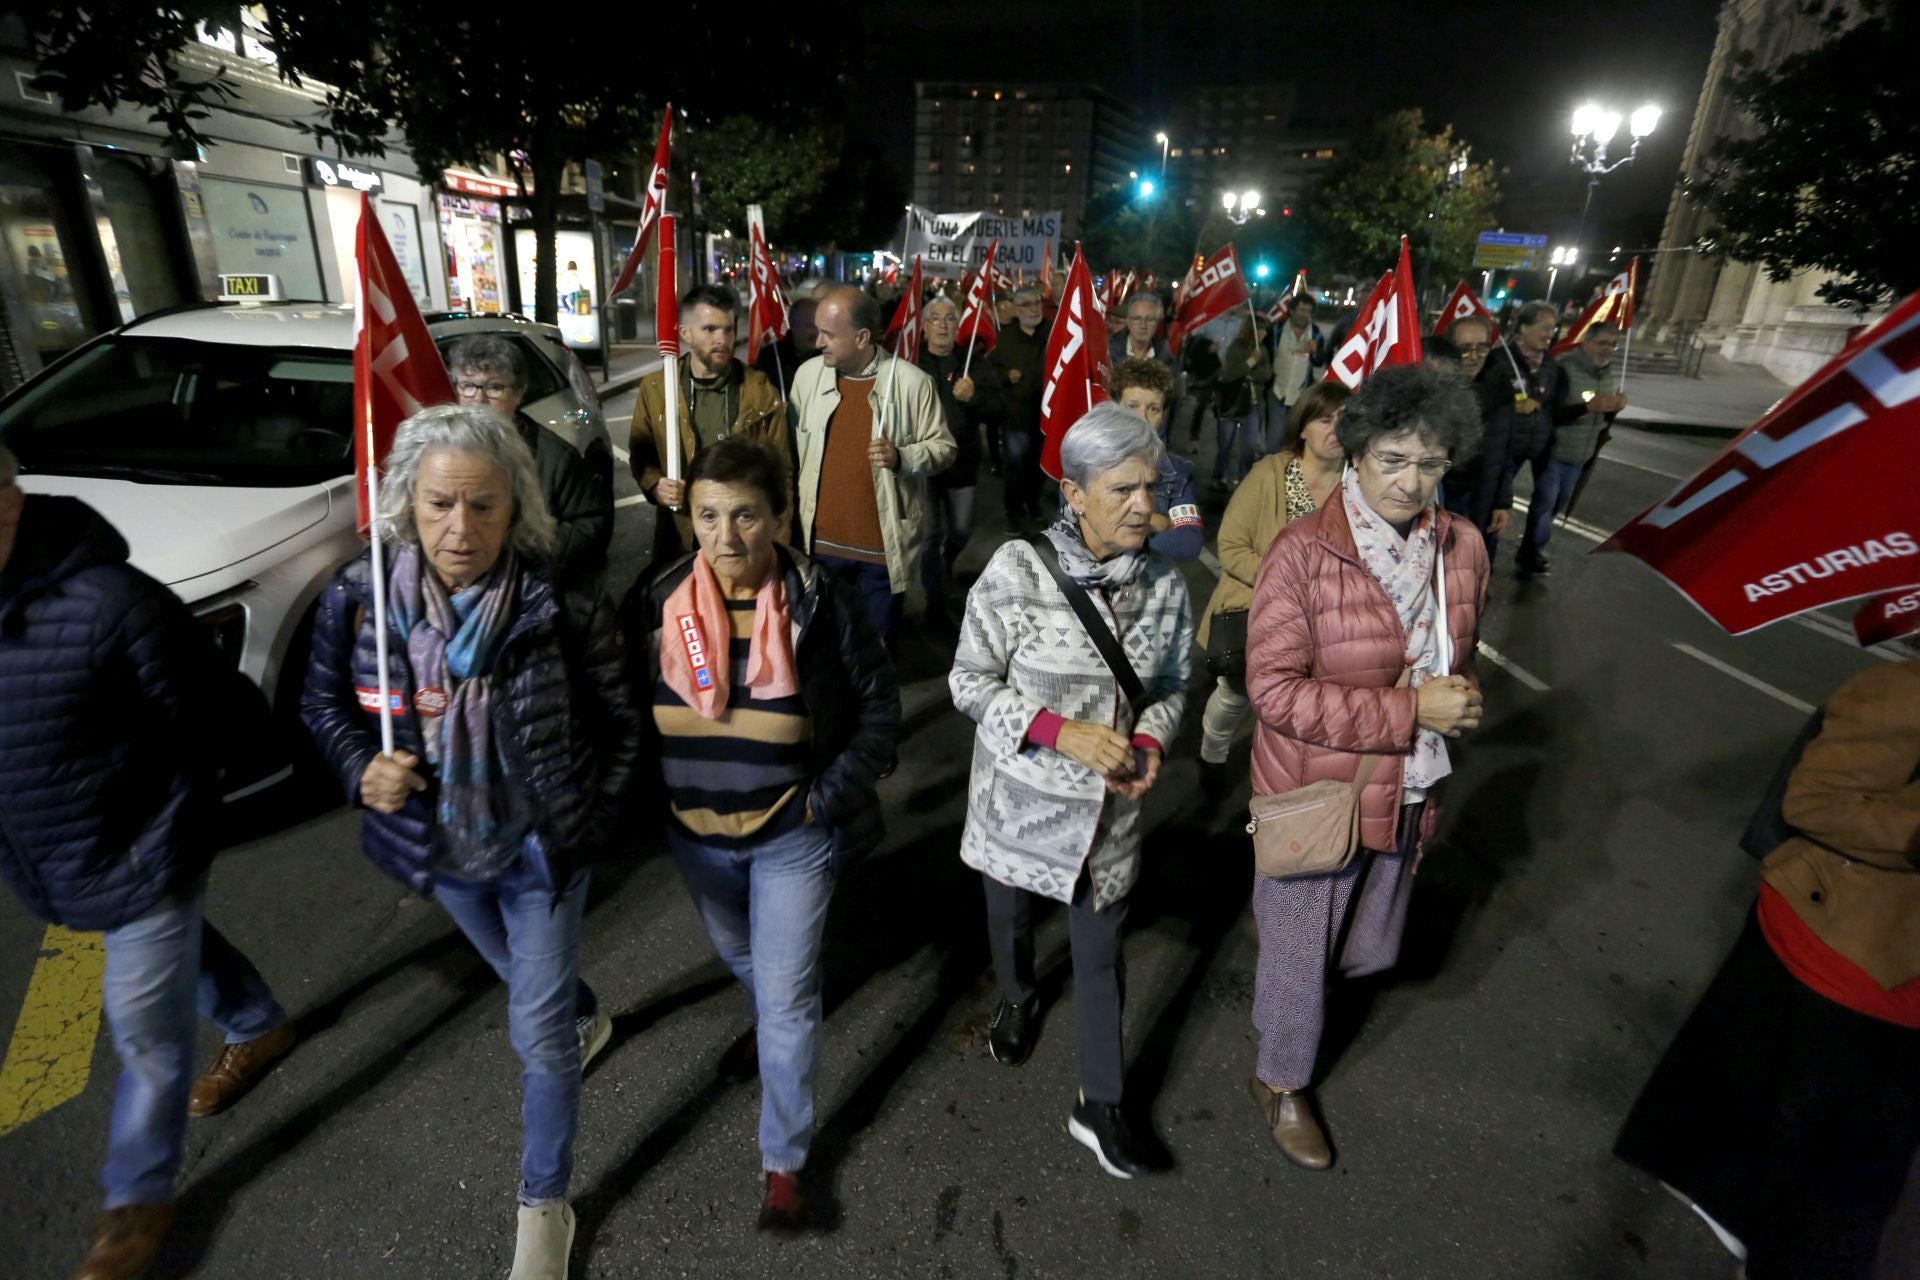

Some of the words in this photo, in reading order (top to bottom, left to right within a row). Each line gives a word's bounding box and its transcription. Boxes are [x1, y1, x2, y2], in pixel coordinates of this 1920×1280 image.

[912, 214, 926, 232] NI
[930, 218, 959, 239] UNA
[965, 218, 1018, 238] MUERTE
[928, 243, 947, 261] EN
[951, 245, 966, 263] EL
[973, 244, 1034, 264] TRBAJO
[227, 277, 258, 295] TAXI
[1743, 531, 1920, 603] ASTURIAS
[680, 615, 706, 668] CCOO
